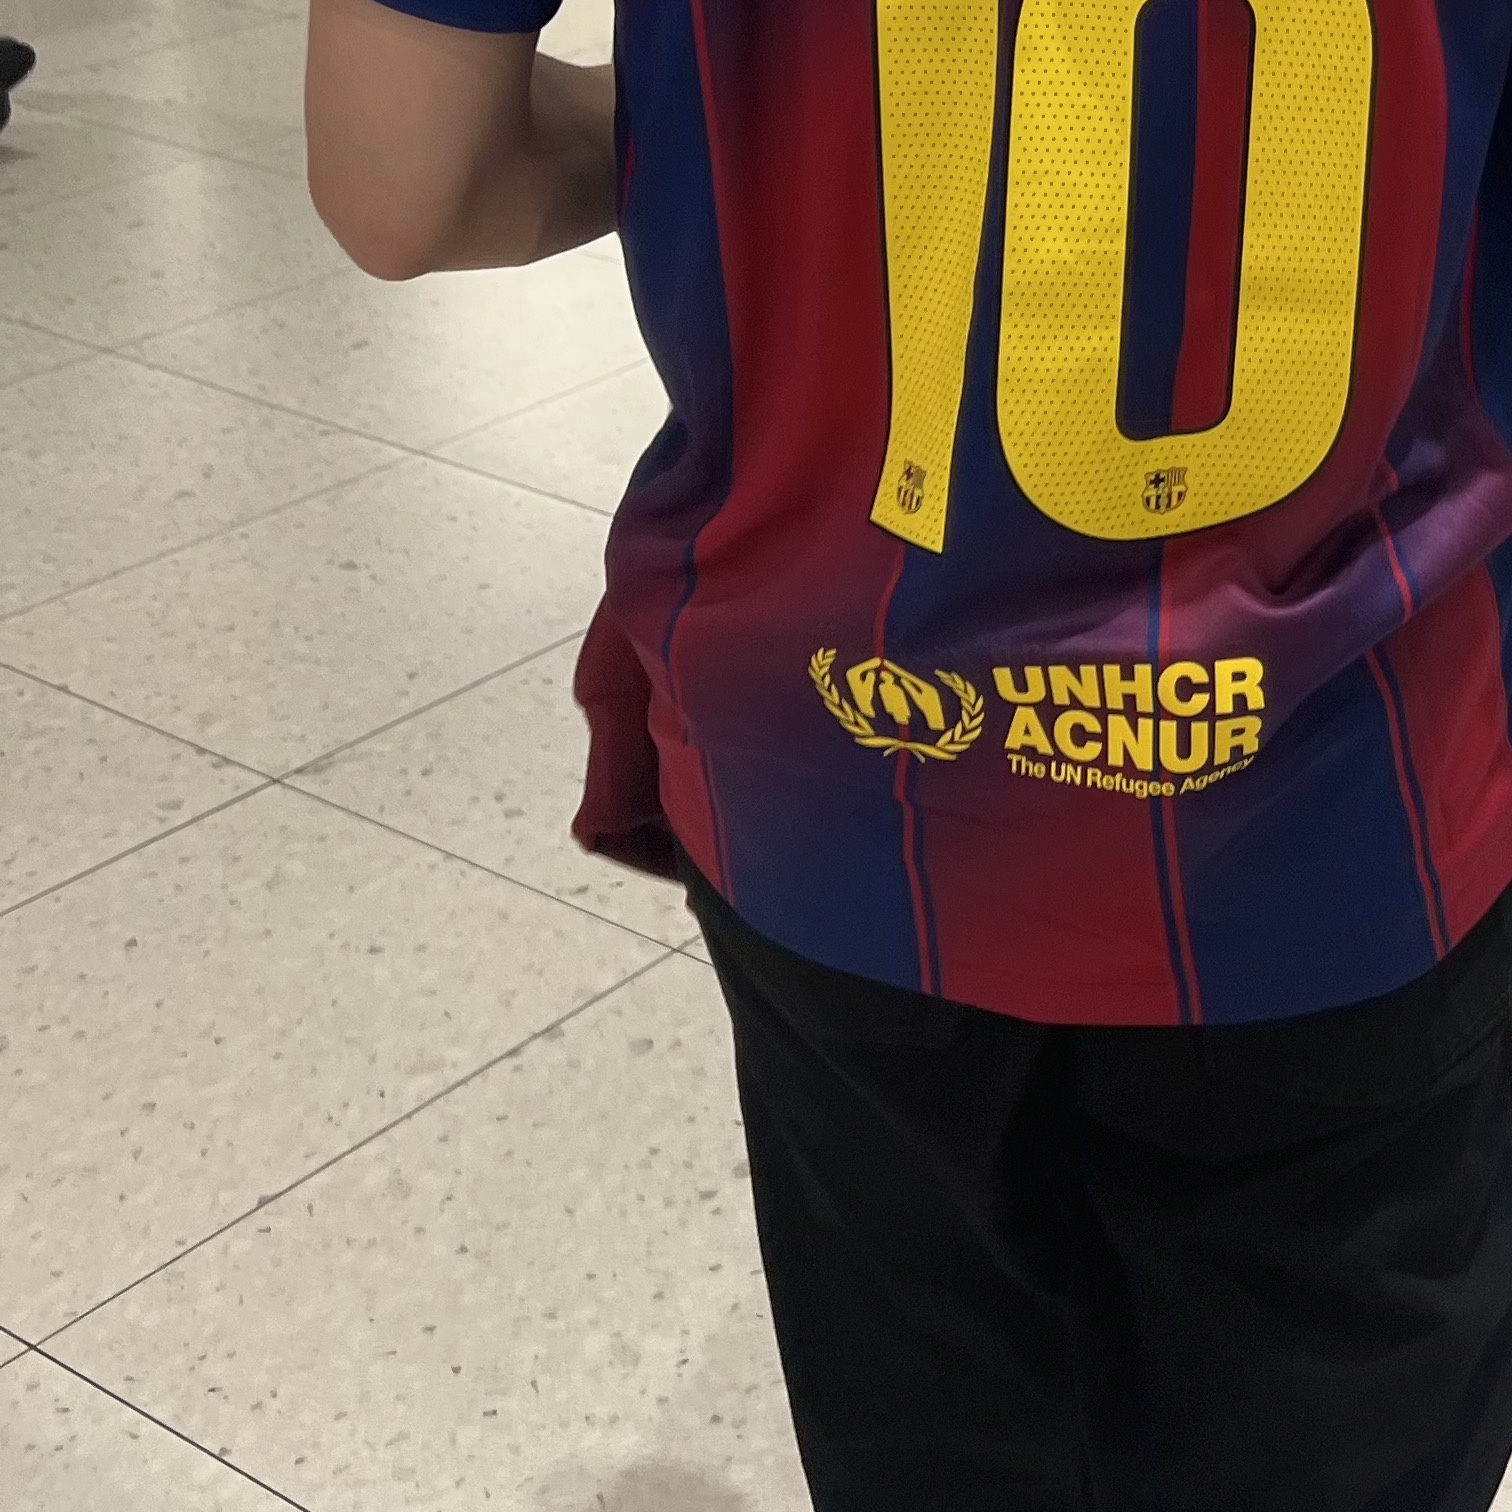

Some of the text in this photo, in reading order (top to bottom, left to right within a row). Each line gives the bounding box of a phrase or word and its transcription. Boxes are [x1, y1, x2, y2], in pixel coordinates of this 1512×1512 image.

[992, 656, 1266, 718] UNHCR
[1004, 706, 1264, 775] ACNUR
[1008, 753, 1255, 799] The UN Refugee Agency
